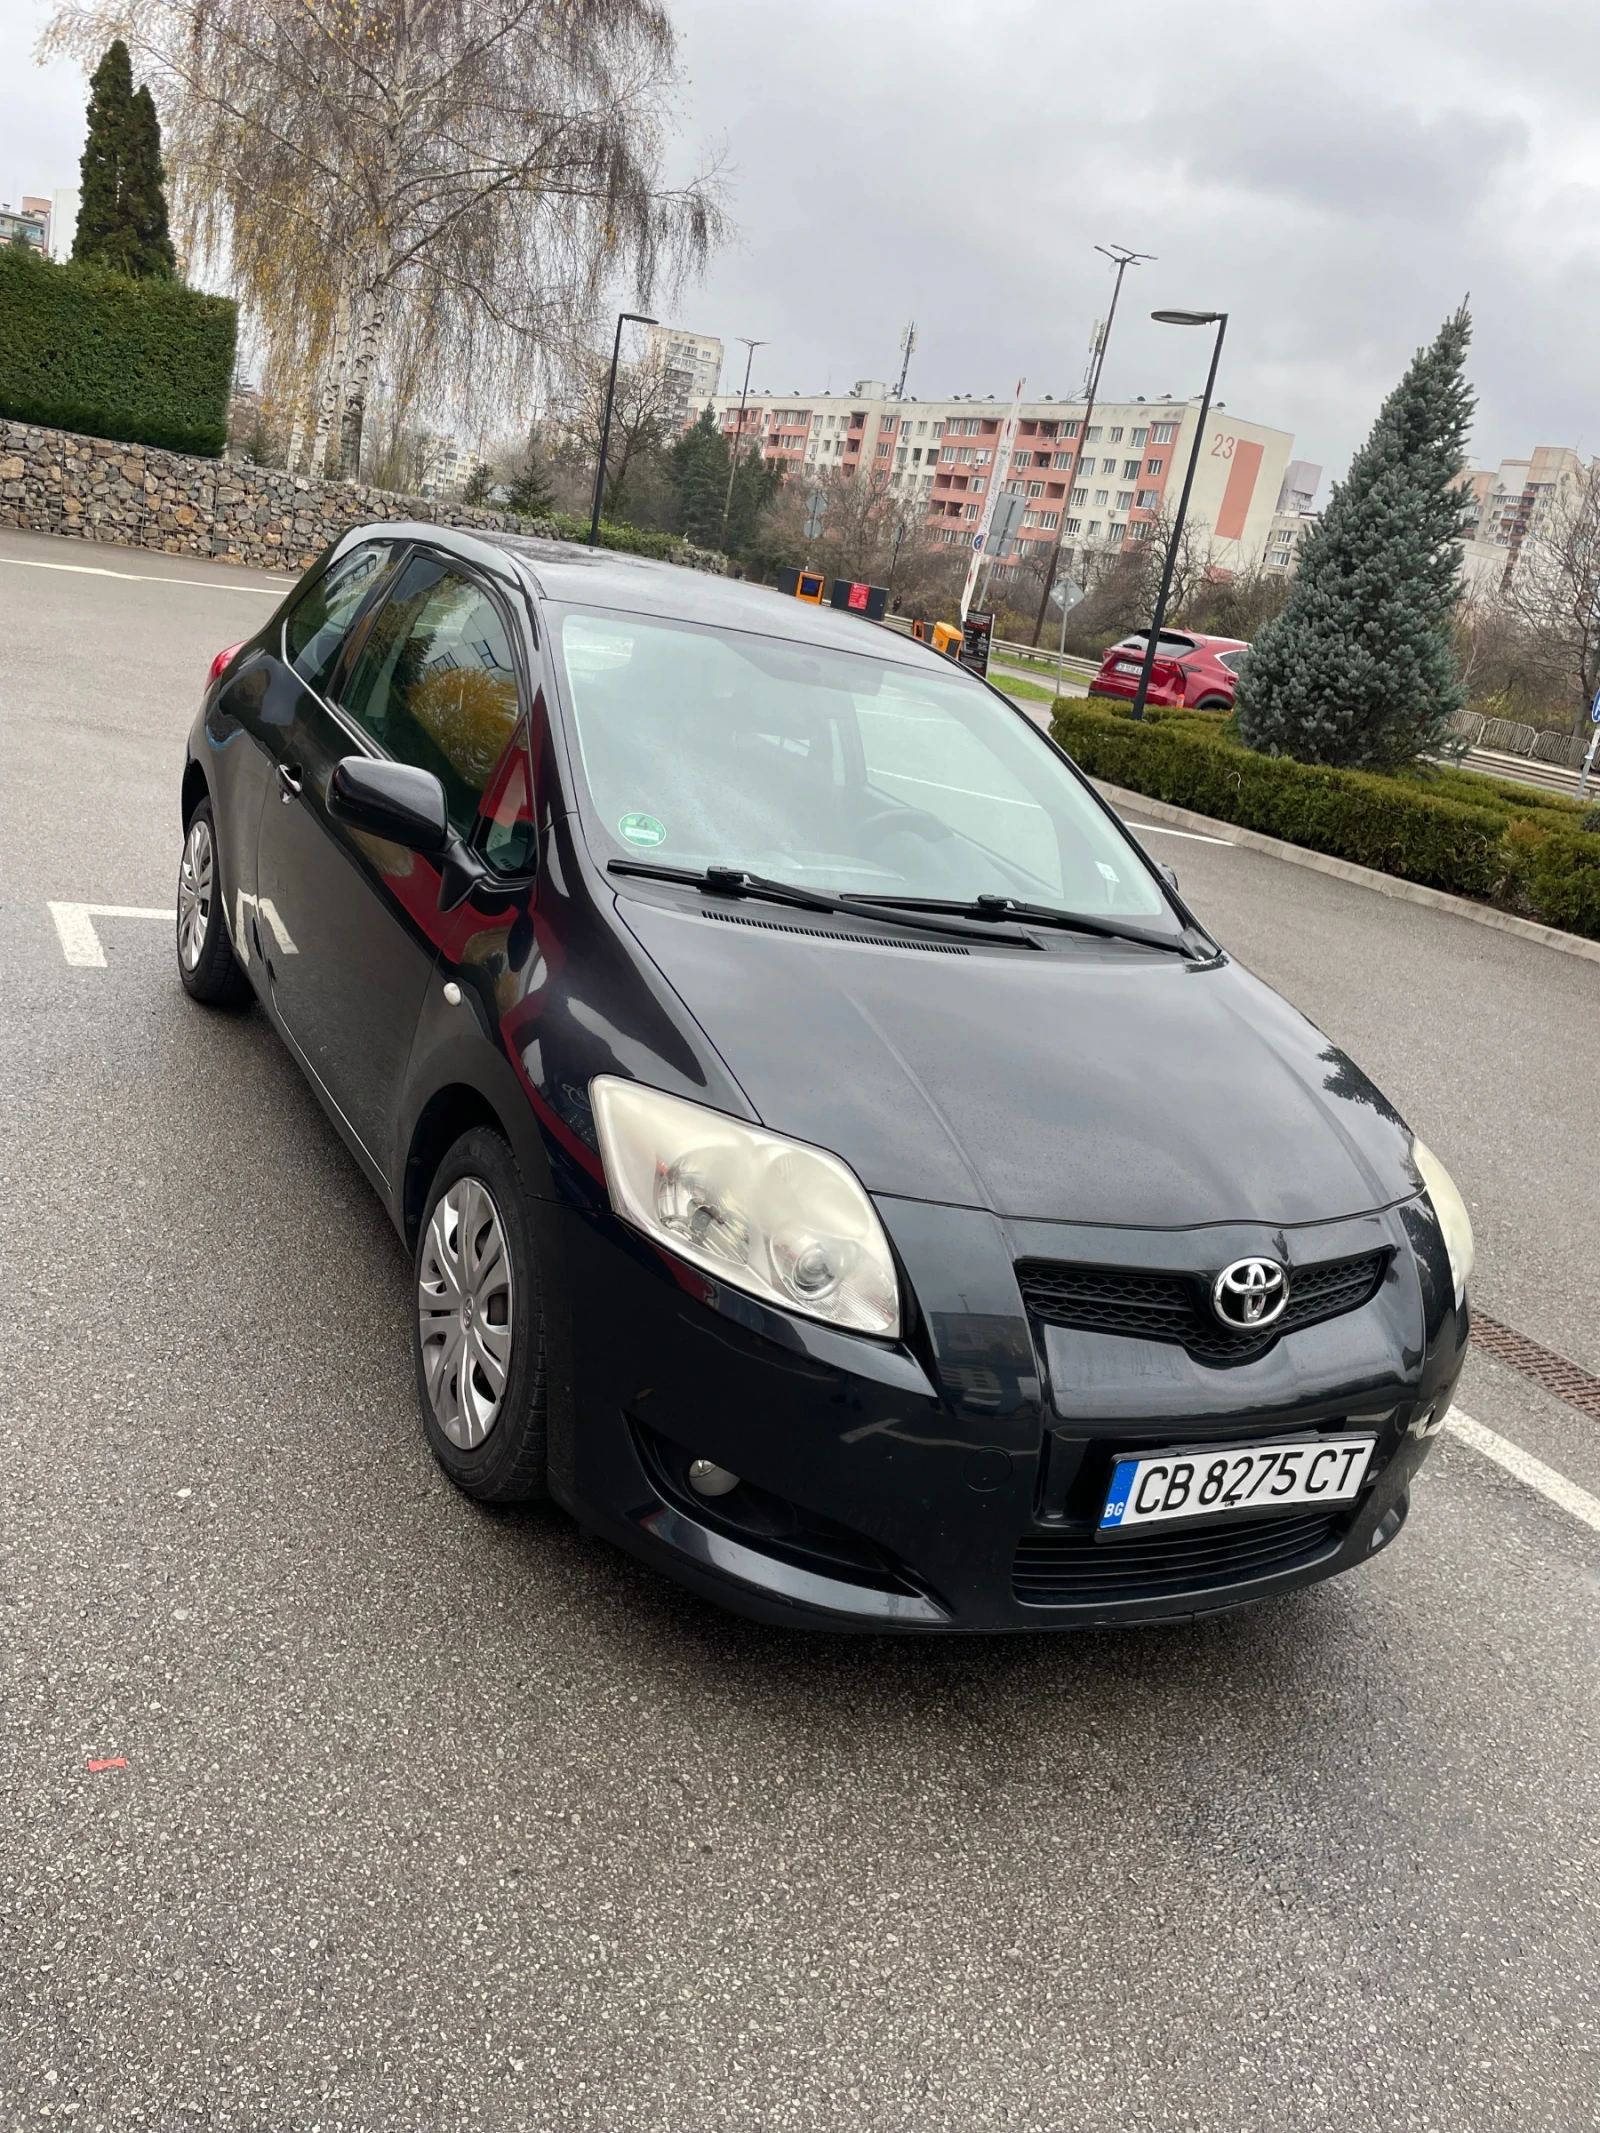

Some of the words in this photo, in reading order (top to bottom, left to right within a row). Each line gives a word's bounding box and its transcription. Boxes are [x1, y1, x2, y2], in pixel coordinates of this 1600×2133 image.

[1211, 433, 1235, 459] 23
[636, 816, 649, 829] 4
[1134, 1463, 1195, 1515] CB
[1199, 1451, 1303, 1506] 8275
[1304, 1446, 1365, 1494] CT
[1103, 1501, 1125, 1518] BG
